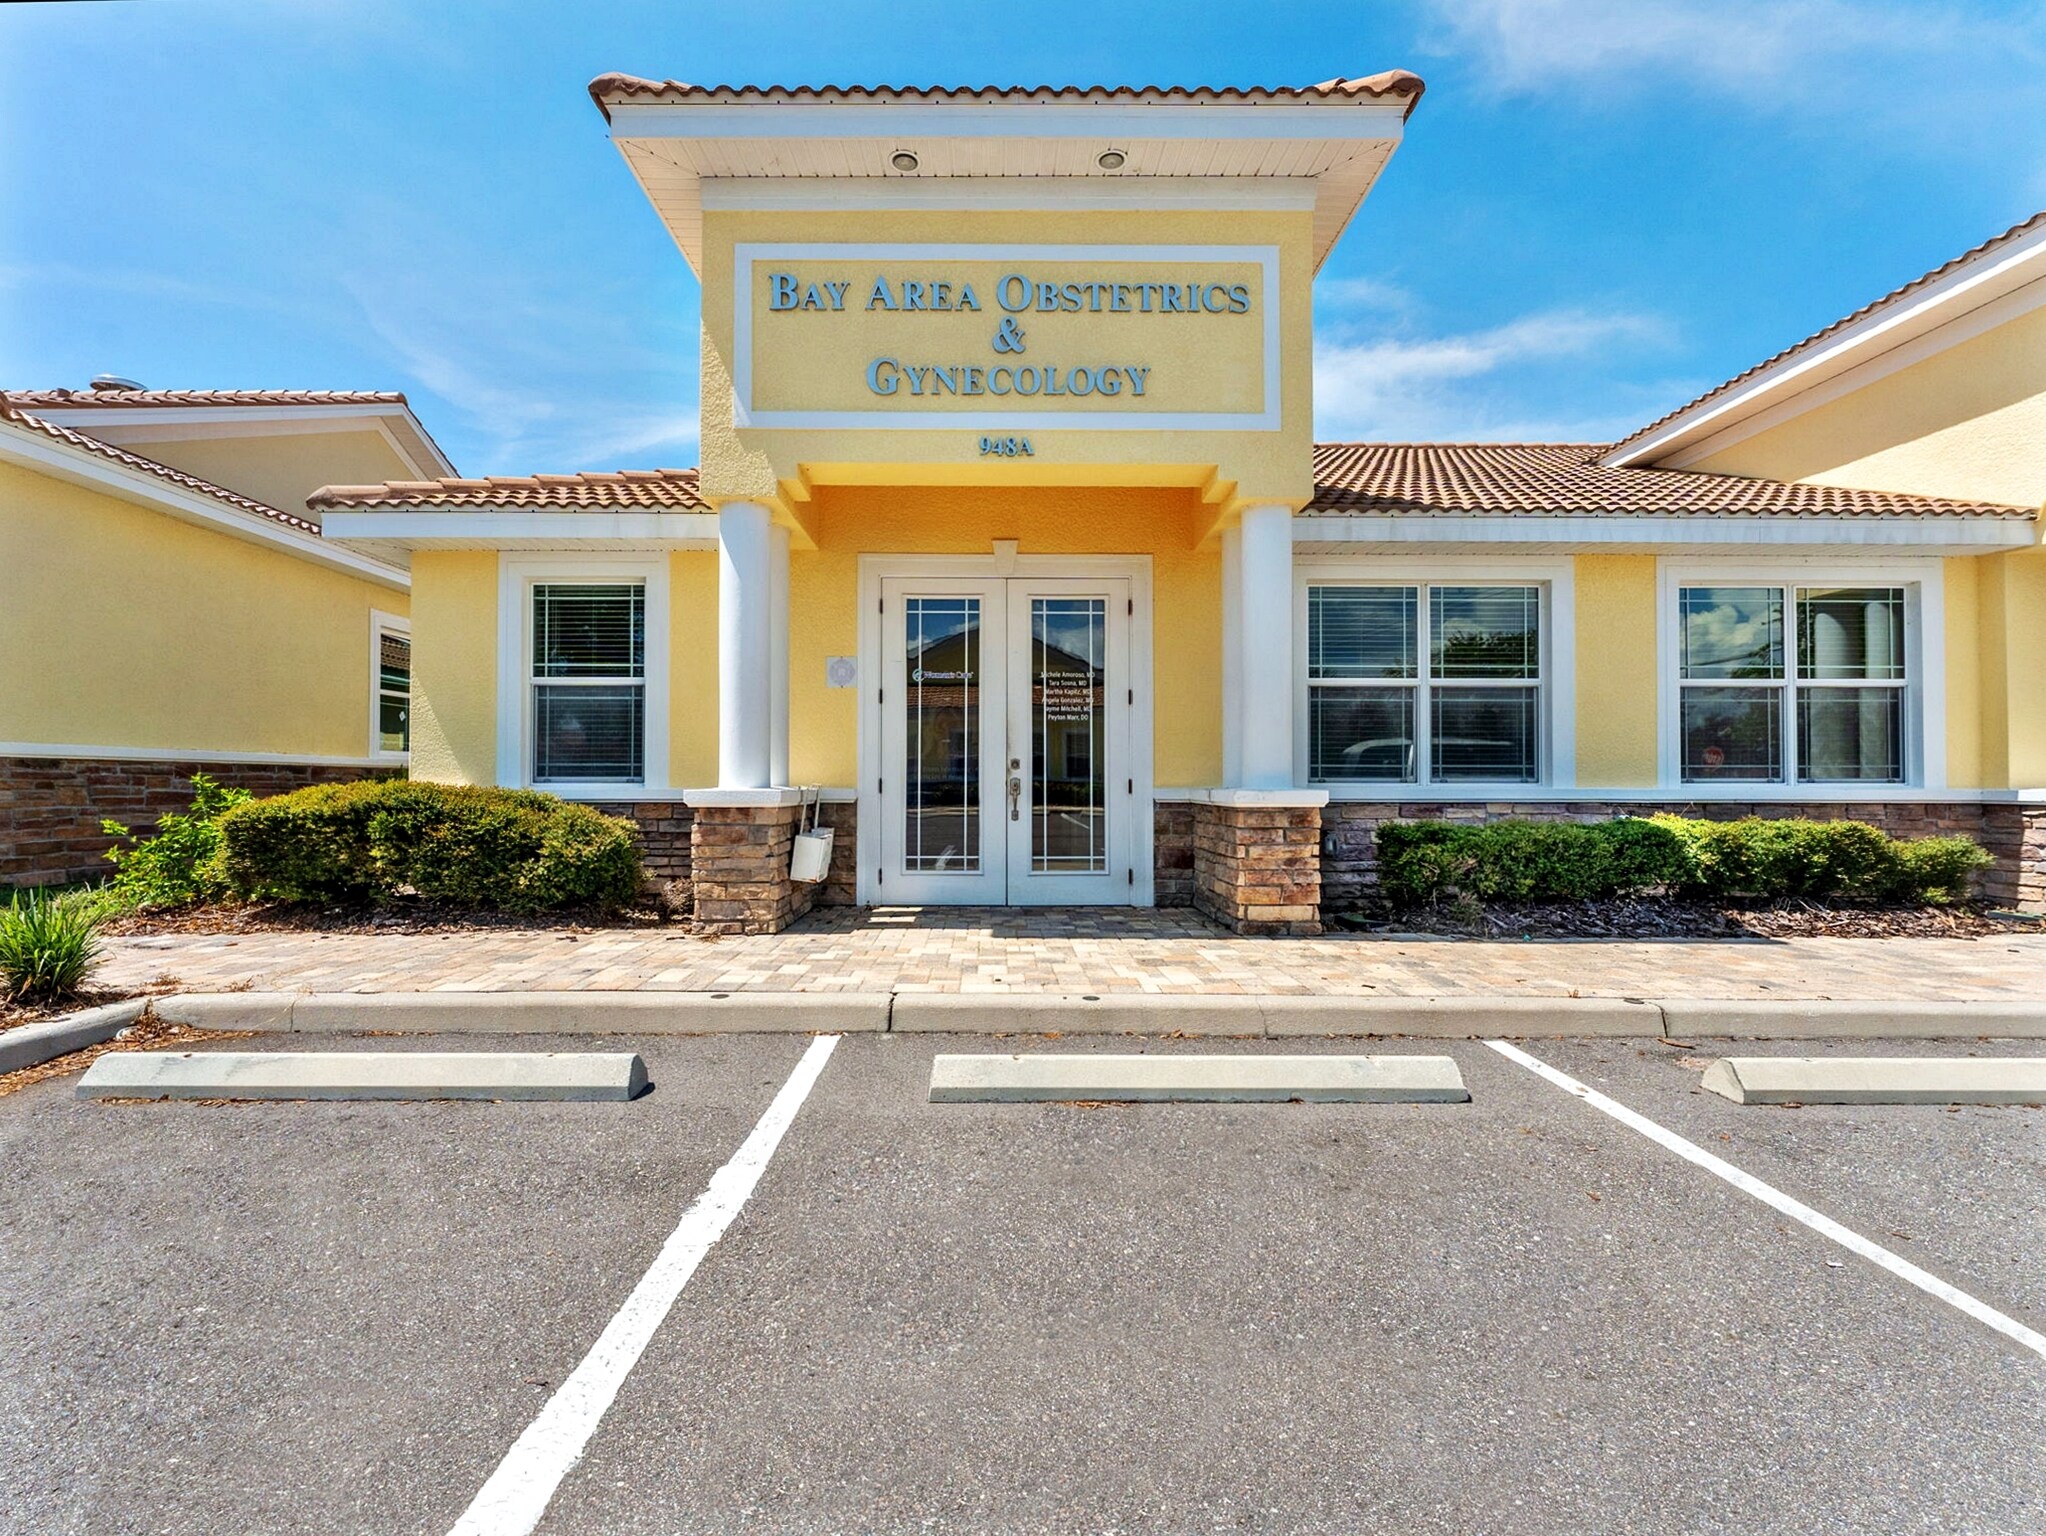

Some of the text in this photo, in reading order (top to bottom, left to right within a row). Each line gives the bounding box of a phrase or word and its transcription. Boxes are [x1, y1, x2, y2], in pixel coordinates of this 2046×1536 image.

[769, 273, 1251, 314] BAY AREA OBSTETRICS
[991, 315, 1026, 353] &
[866, 357, 1151, 397] GYNECOLOGY
[978, 436, 1035, 456] 948A
